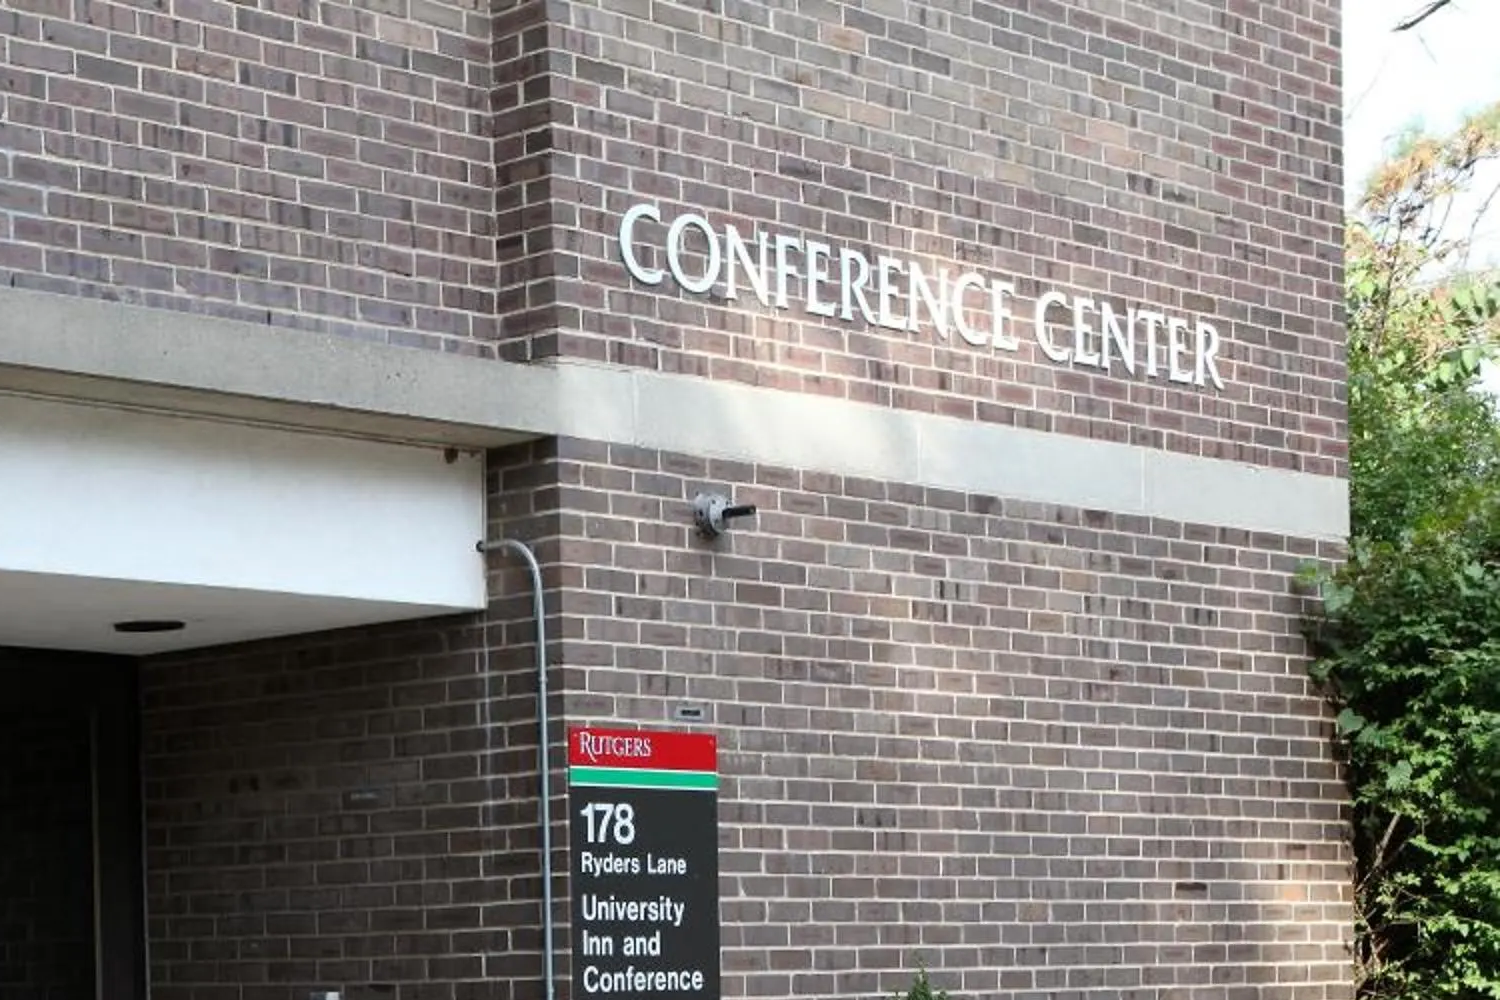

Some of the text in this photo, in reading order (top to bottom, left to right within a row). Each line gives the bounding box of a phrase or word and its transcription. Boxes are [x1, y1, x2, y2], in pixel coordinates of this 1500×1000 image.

[619, 203, 1225, 390] CONFERENCE CENTER
[580, 731, 651, 763] RUTGERS
[581, 803, 635, 845] 178
[581, 852, 687, 877] Ryders Lane
[582, 894, 684, 926] University
[583, 930, 661, 956] Inn and
[583, 966, 704, 992] Conference
